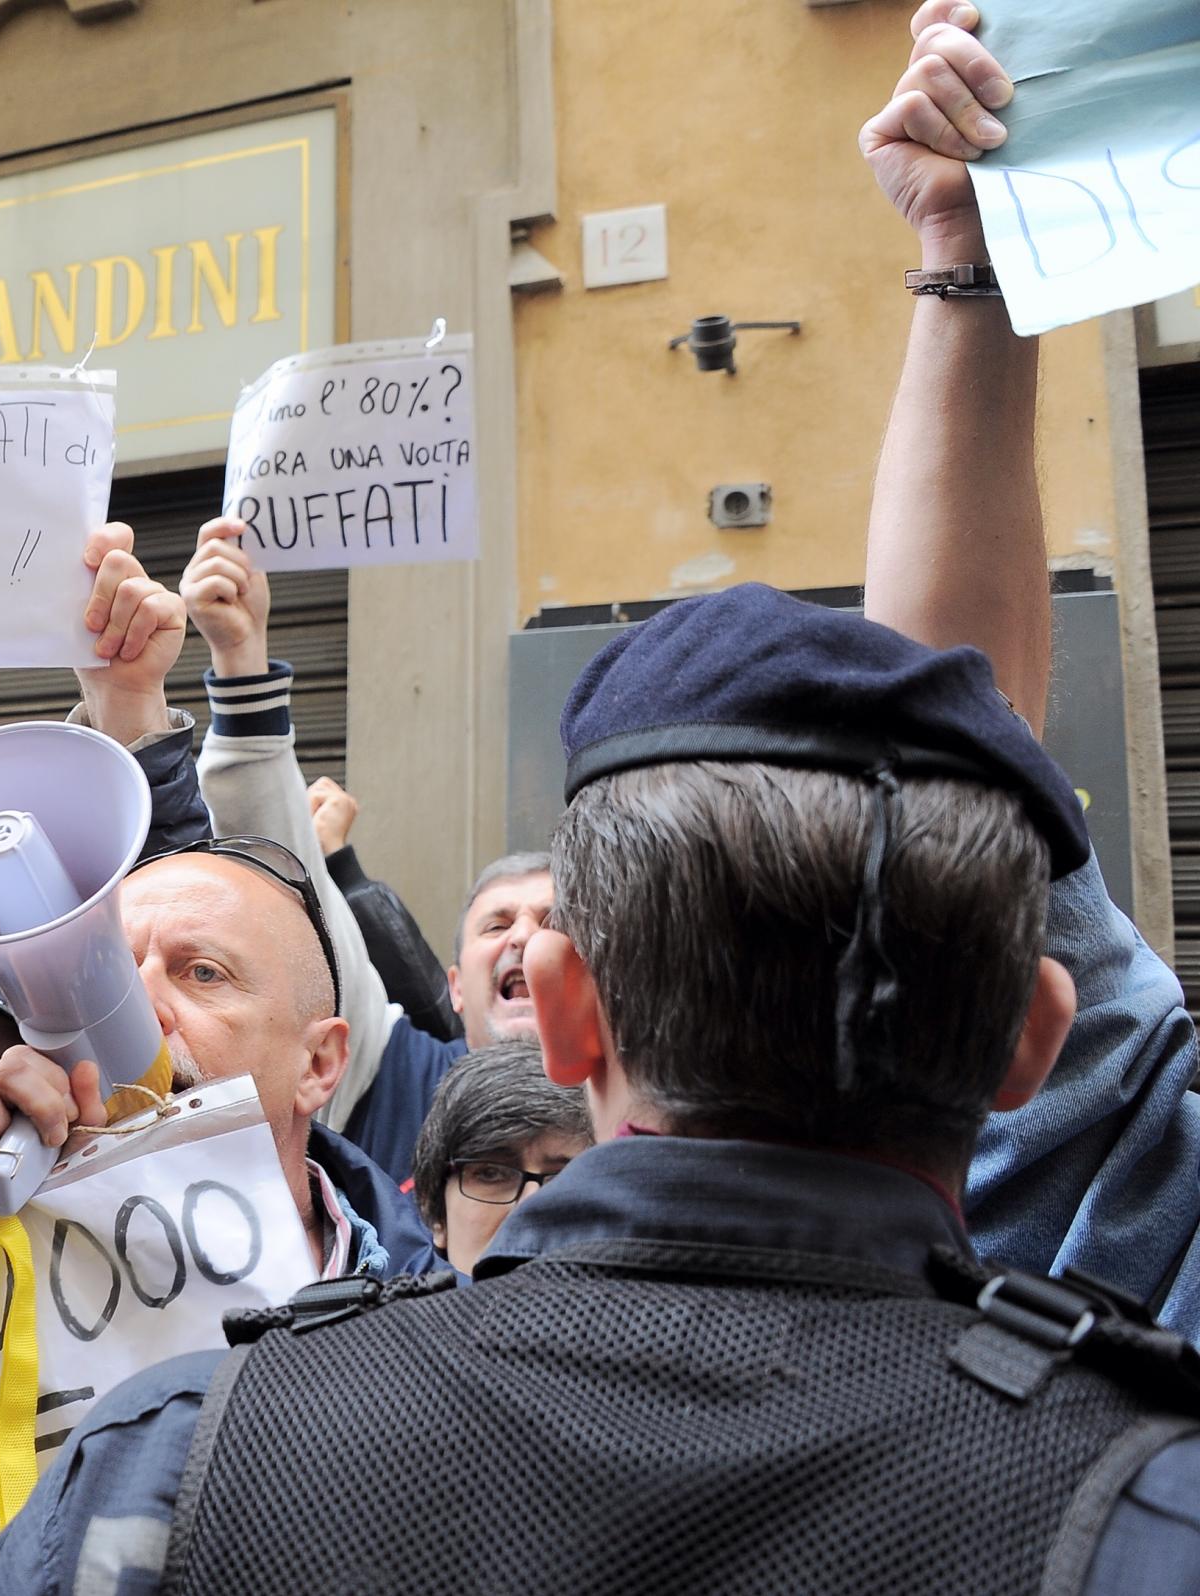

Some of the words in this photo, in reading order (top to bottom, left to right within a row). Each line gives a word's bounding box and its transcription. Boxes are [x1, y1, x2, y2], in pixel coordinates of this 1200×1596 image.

[601, 223, 647, 267] 12
[64, 434, 97, 467] di
[236, 450, 308, 483] CORA
[330, 444, 385, 471] UNA
[399, 440, 471, 468] VOLTA
[230, 473, 451, 551] RUFFATI
